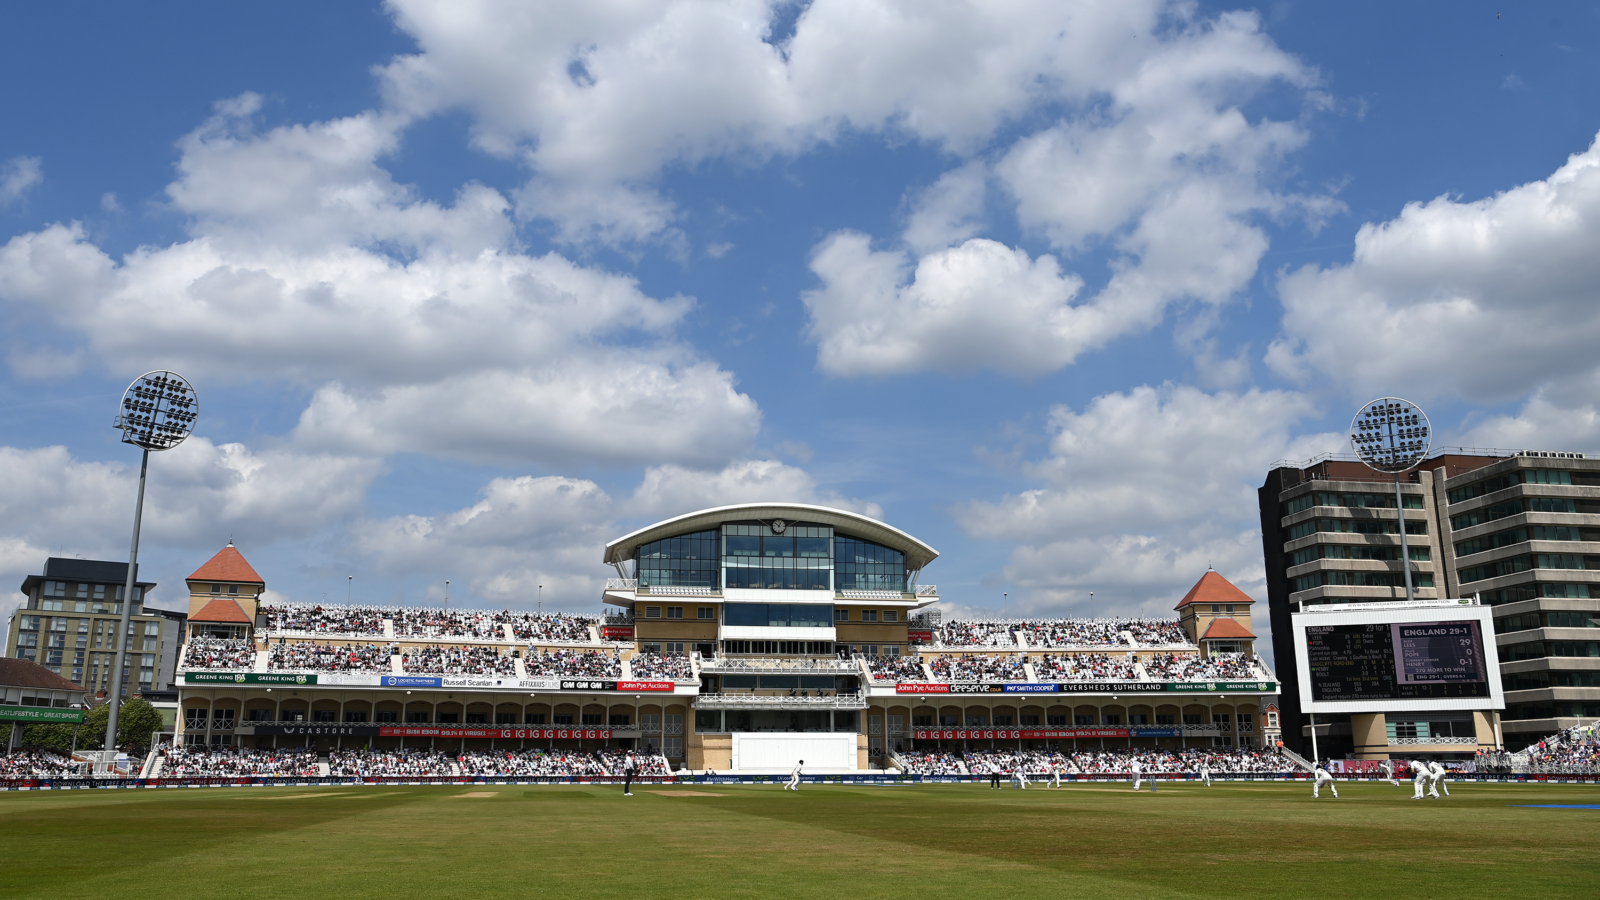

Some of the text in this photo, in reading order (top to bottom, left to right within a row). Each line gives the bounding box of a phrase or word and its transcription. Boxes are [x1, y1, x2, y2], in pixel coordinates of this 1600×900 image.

[501, 729, 511, 737] IG
[516, 730, 525, 738] IG
[530, 730, 539, 738] IG
[544, 730, 553, 738] IG
[558, 730, 568, 738] IG
[572, 730, 581, 738] IG
[586, 730, 596, 738] IG
[600, 730, 609, 738] IG
